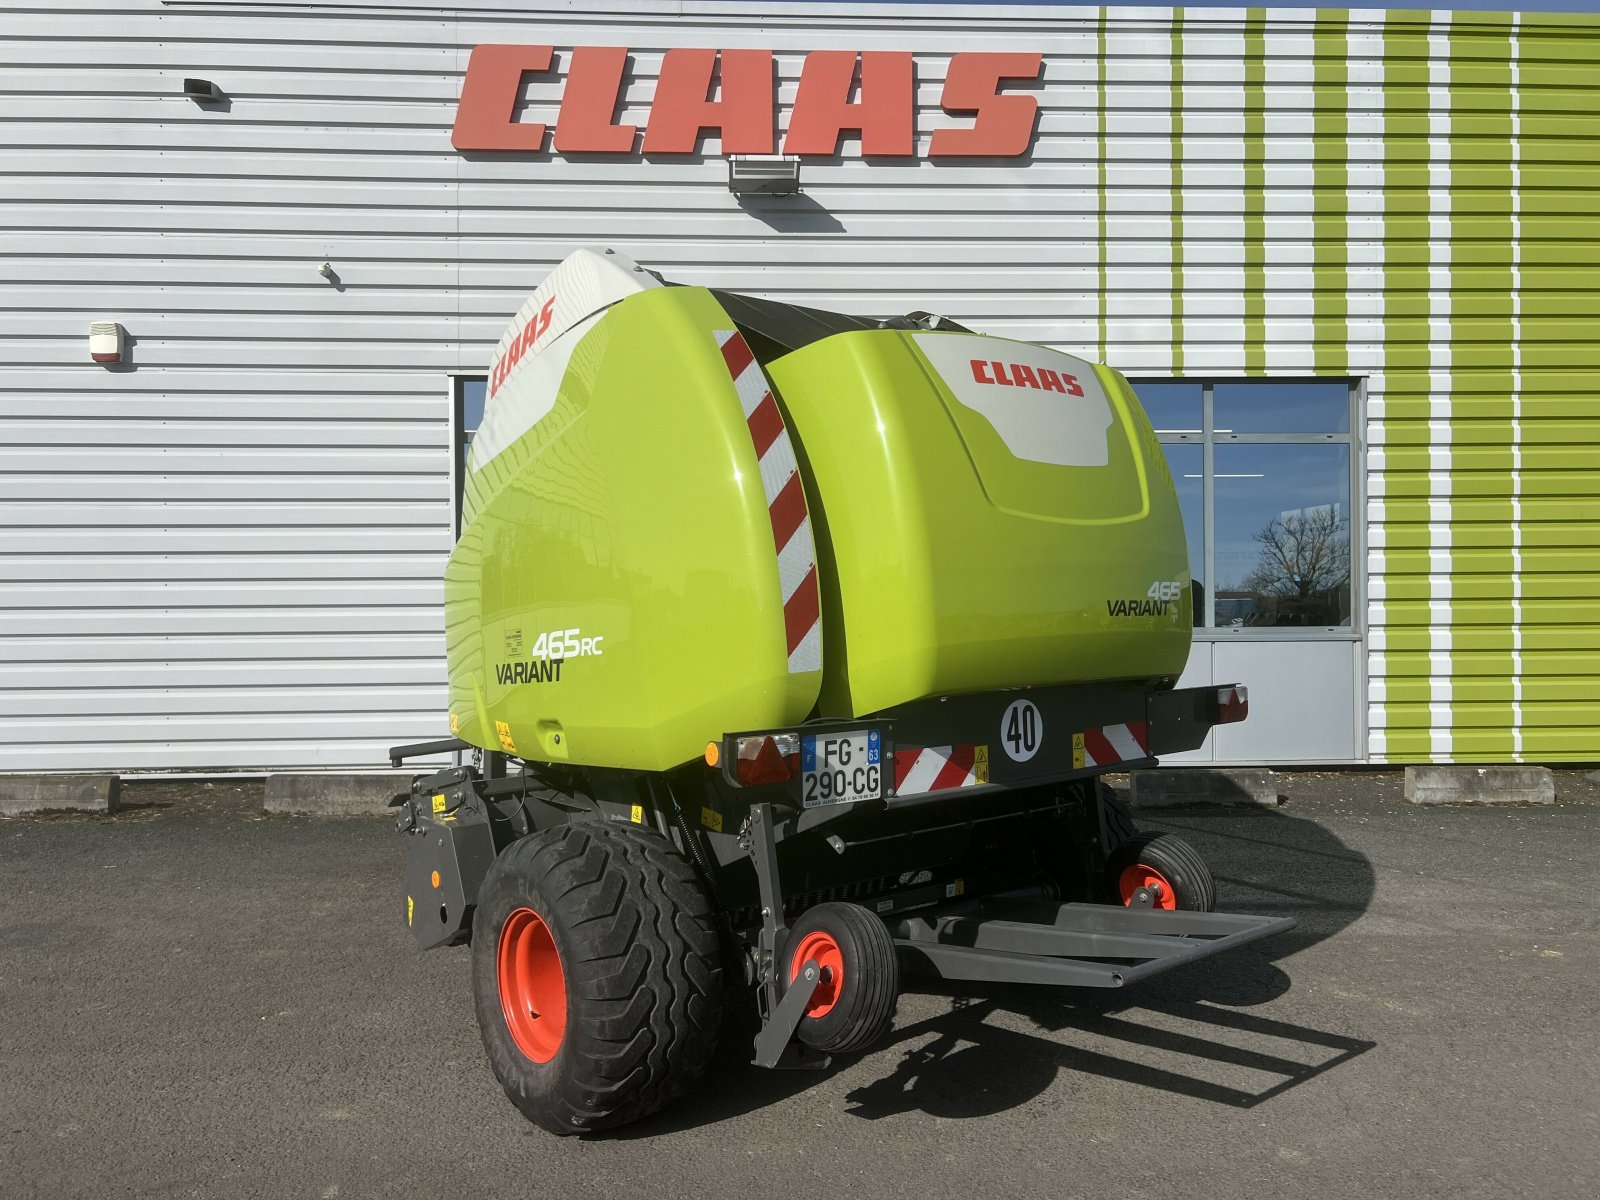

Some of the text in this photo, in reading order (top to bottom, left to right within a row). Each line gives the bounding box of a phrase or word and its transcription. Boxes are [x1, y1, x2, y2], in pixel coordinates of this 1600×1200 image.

[451, 44, 1043, 156] CLAAS
[491, 294, 556, 400] CLAAS
[970, 359, 1084, 397] CLAAS
[1147, 581, 1181, 600] 465
[1106, 600, 1170, 616] VARIANT
[496, 658, 564, 685] VARIANT
[1007, 705, 1036, 753] 40
[806, 754, 813, 763] F
[868, 749, 879, 761] 63
[805, 766, 879, 801] 290-CG
